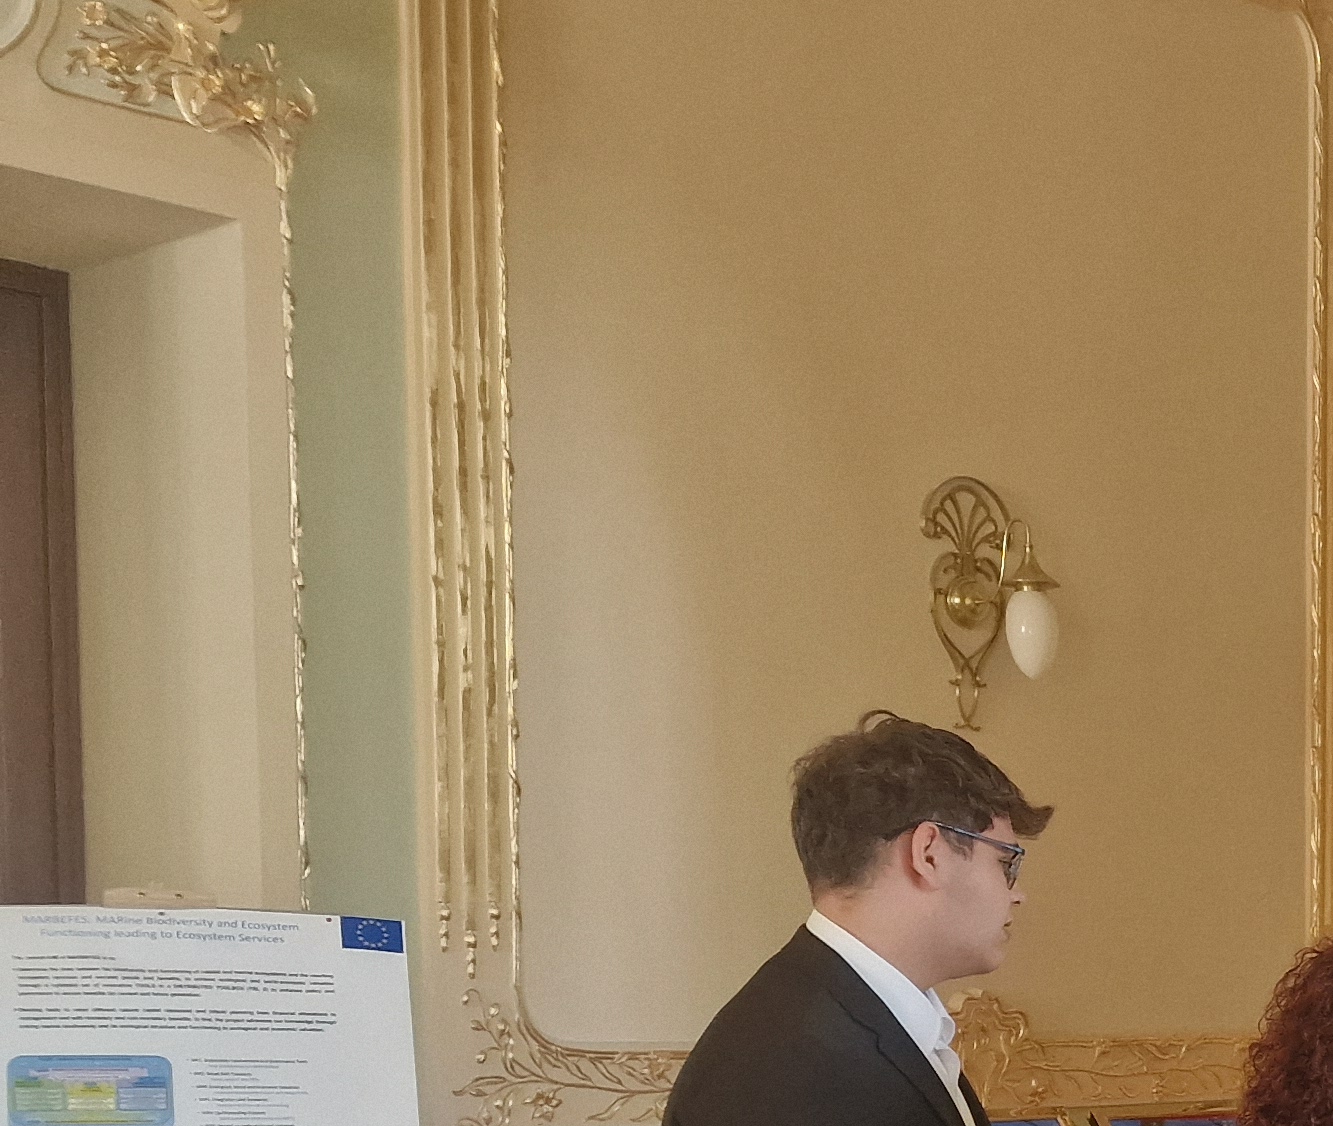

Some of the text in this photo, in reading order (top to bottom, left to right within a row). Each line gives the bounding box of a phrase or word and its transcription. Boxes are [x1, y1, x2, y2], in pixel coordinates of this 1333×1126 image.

[146, 916, 214, 930] Biodiversity
[217, 919, 238, 929] and
[241, 920, 299, 932] Ecosystem
[114, 929, 285, 944] leading to Ecosystem Services
